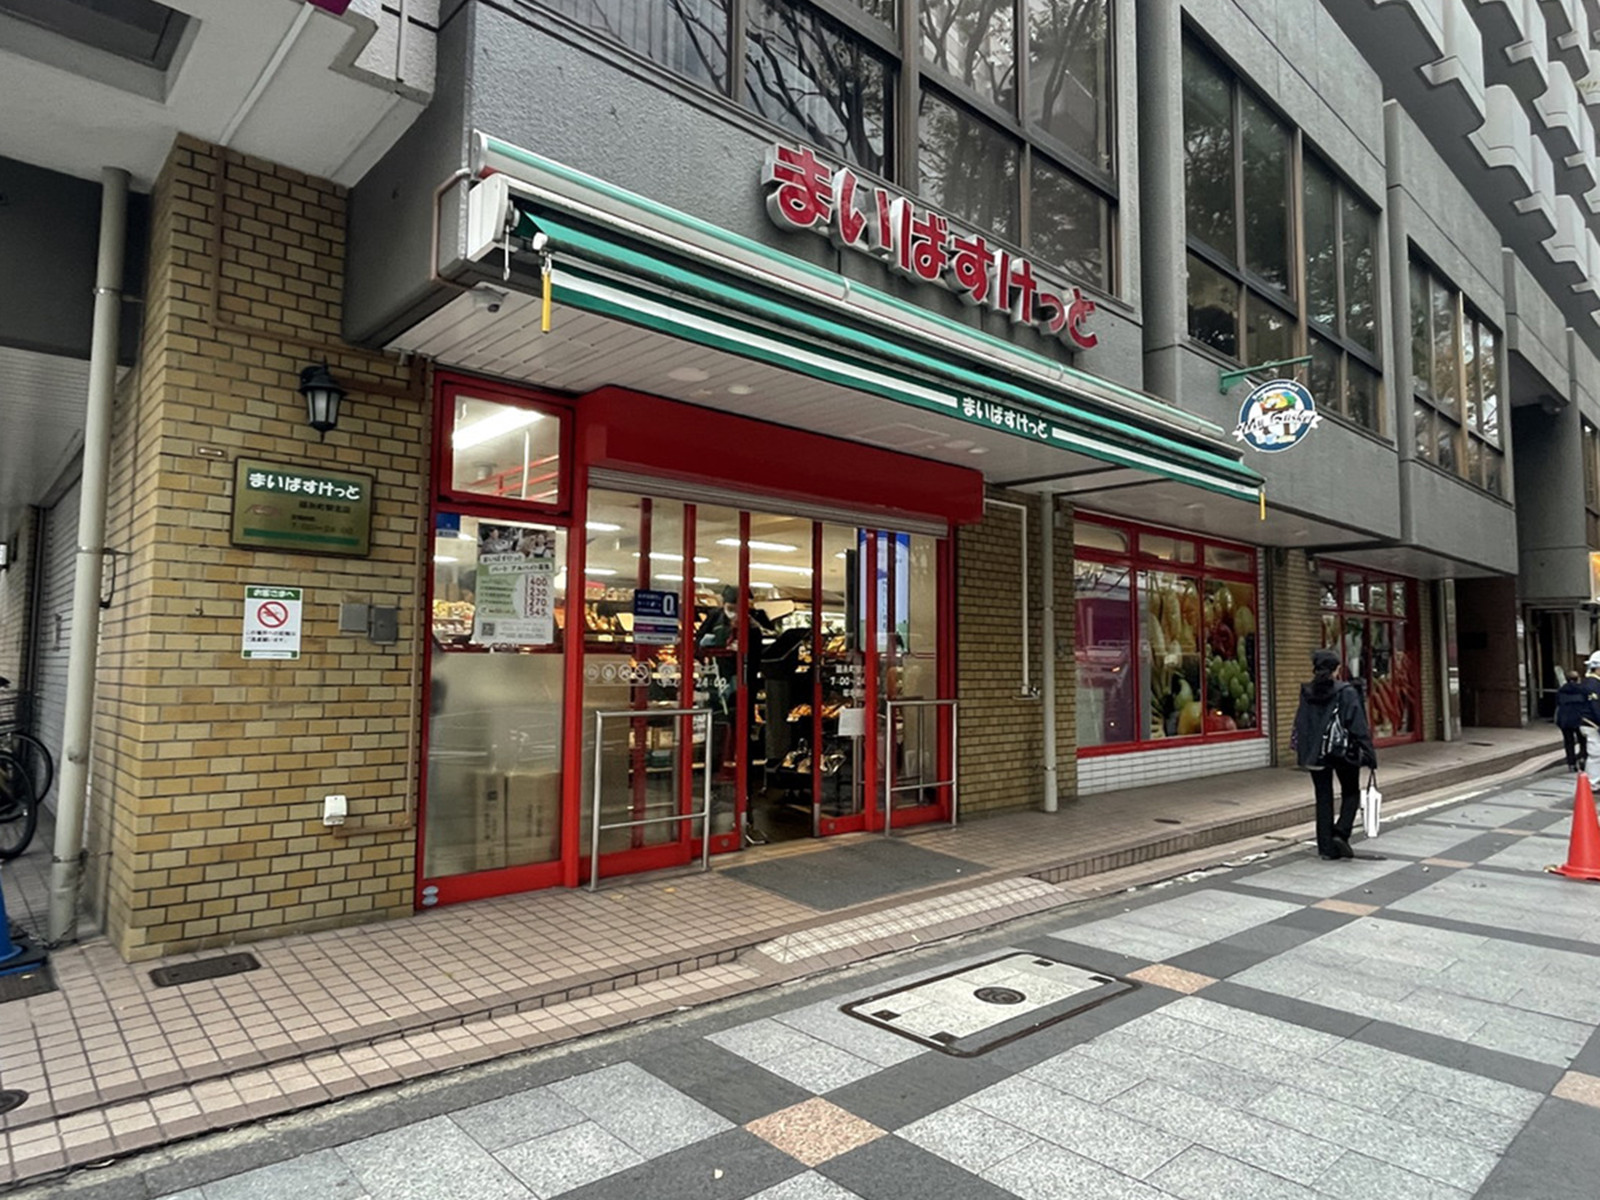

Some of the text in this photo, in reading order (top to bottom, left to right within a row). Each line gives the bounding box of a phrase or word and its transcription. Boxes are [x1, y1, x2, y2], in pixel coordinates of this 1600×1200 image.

[763, 143, 1099, 351] まいばすけっと
[961, 396, 1048, 439] まいばすけっと
[249, 473, 361, 499] まいばすけっと
